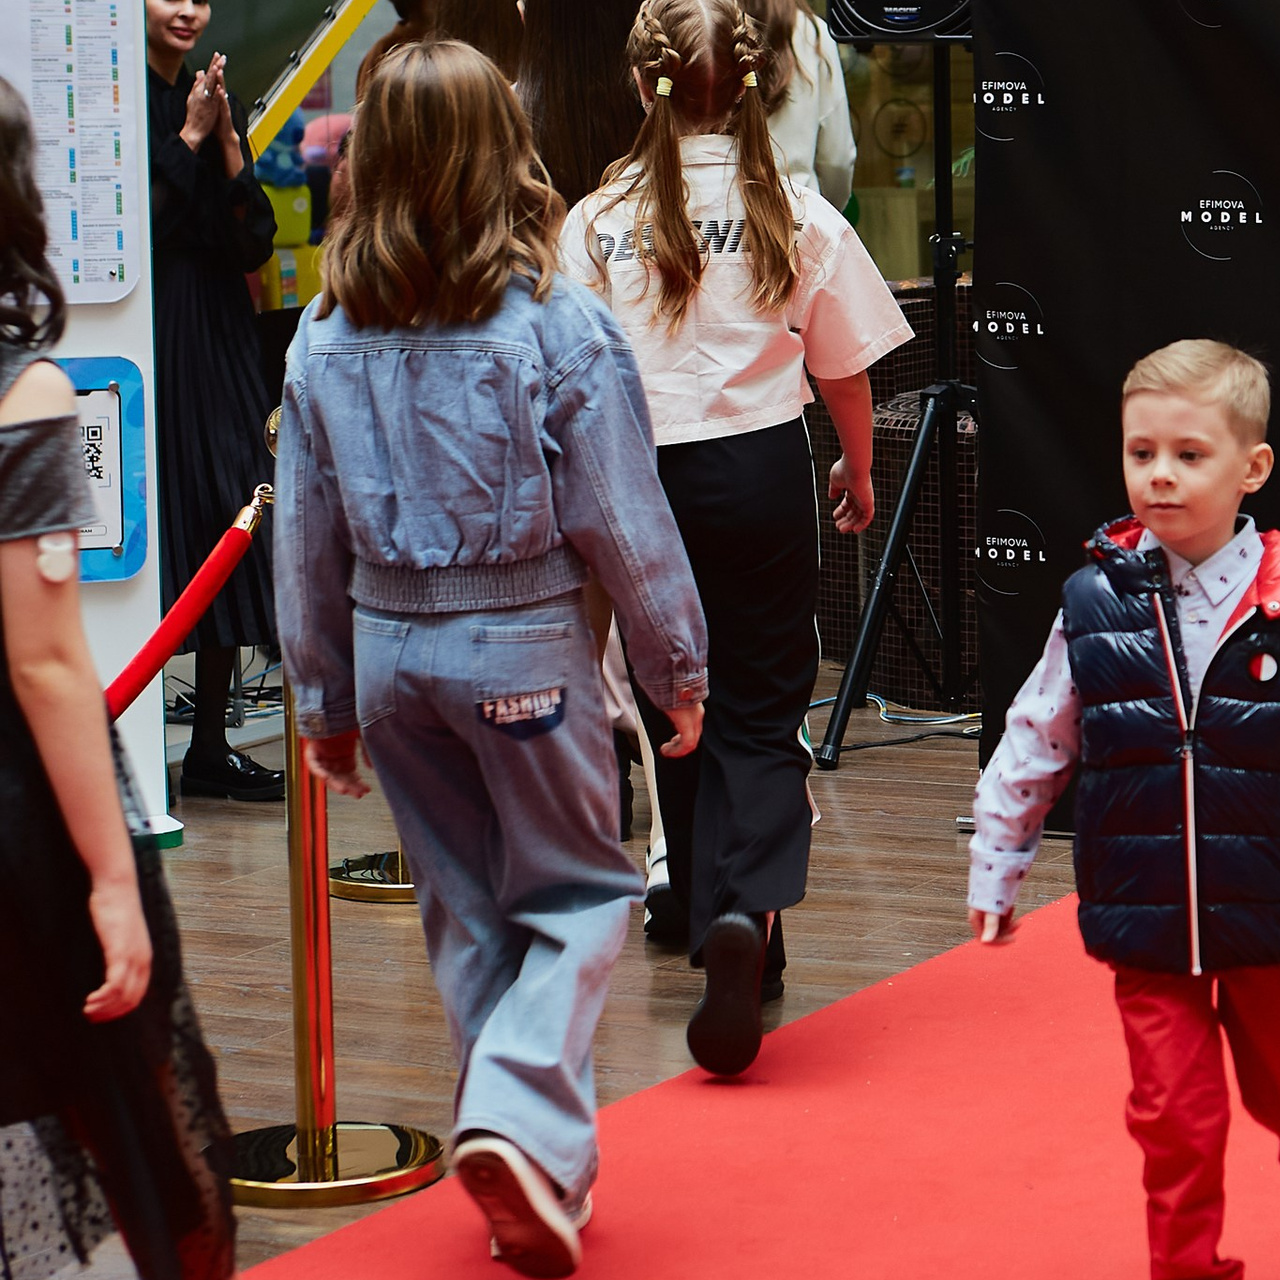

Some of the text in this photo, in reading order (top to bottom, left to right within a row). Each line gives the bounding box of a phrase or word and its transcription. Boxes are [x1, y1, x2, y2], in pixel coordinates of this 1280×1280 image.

[982, 82, 1026, 90] EFIMOVA
[973, 93, 1044, 104] ODEL
[1200, 200, 1244, 209] EFIMOVA
[1181, 211, 1262, 223] MODEL
[987, 311, 1026, 320] EFIMOVA
[987, 537, 1027, 546] EFIMOVA
